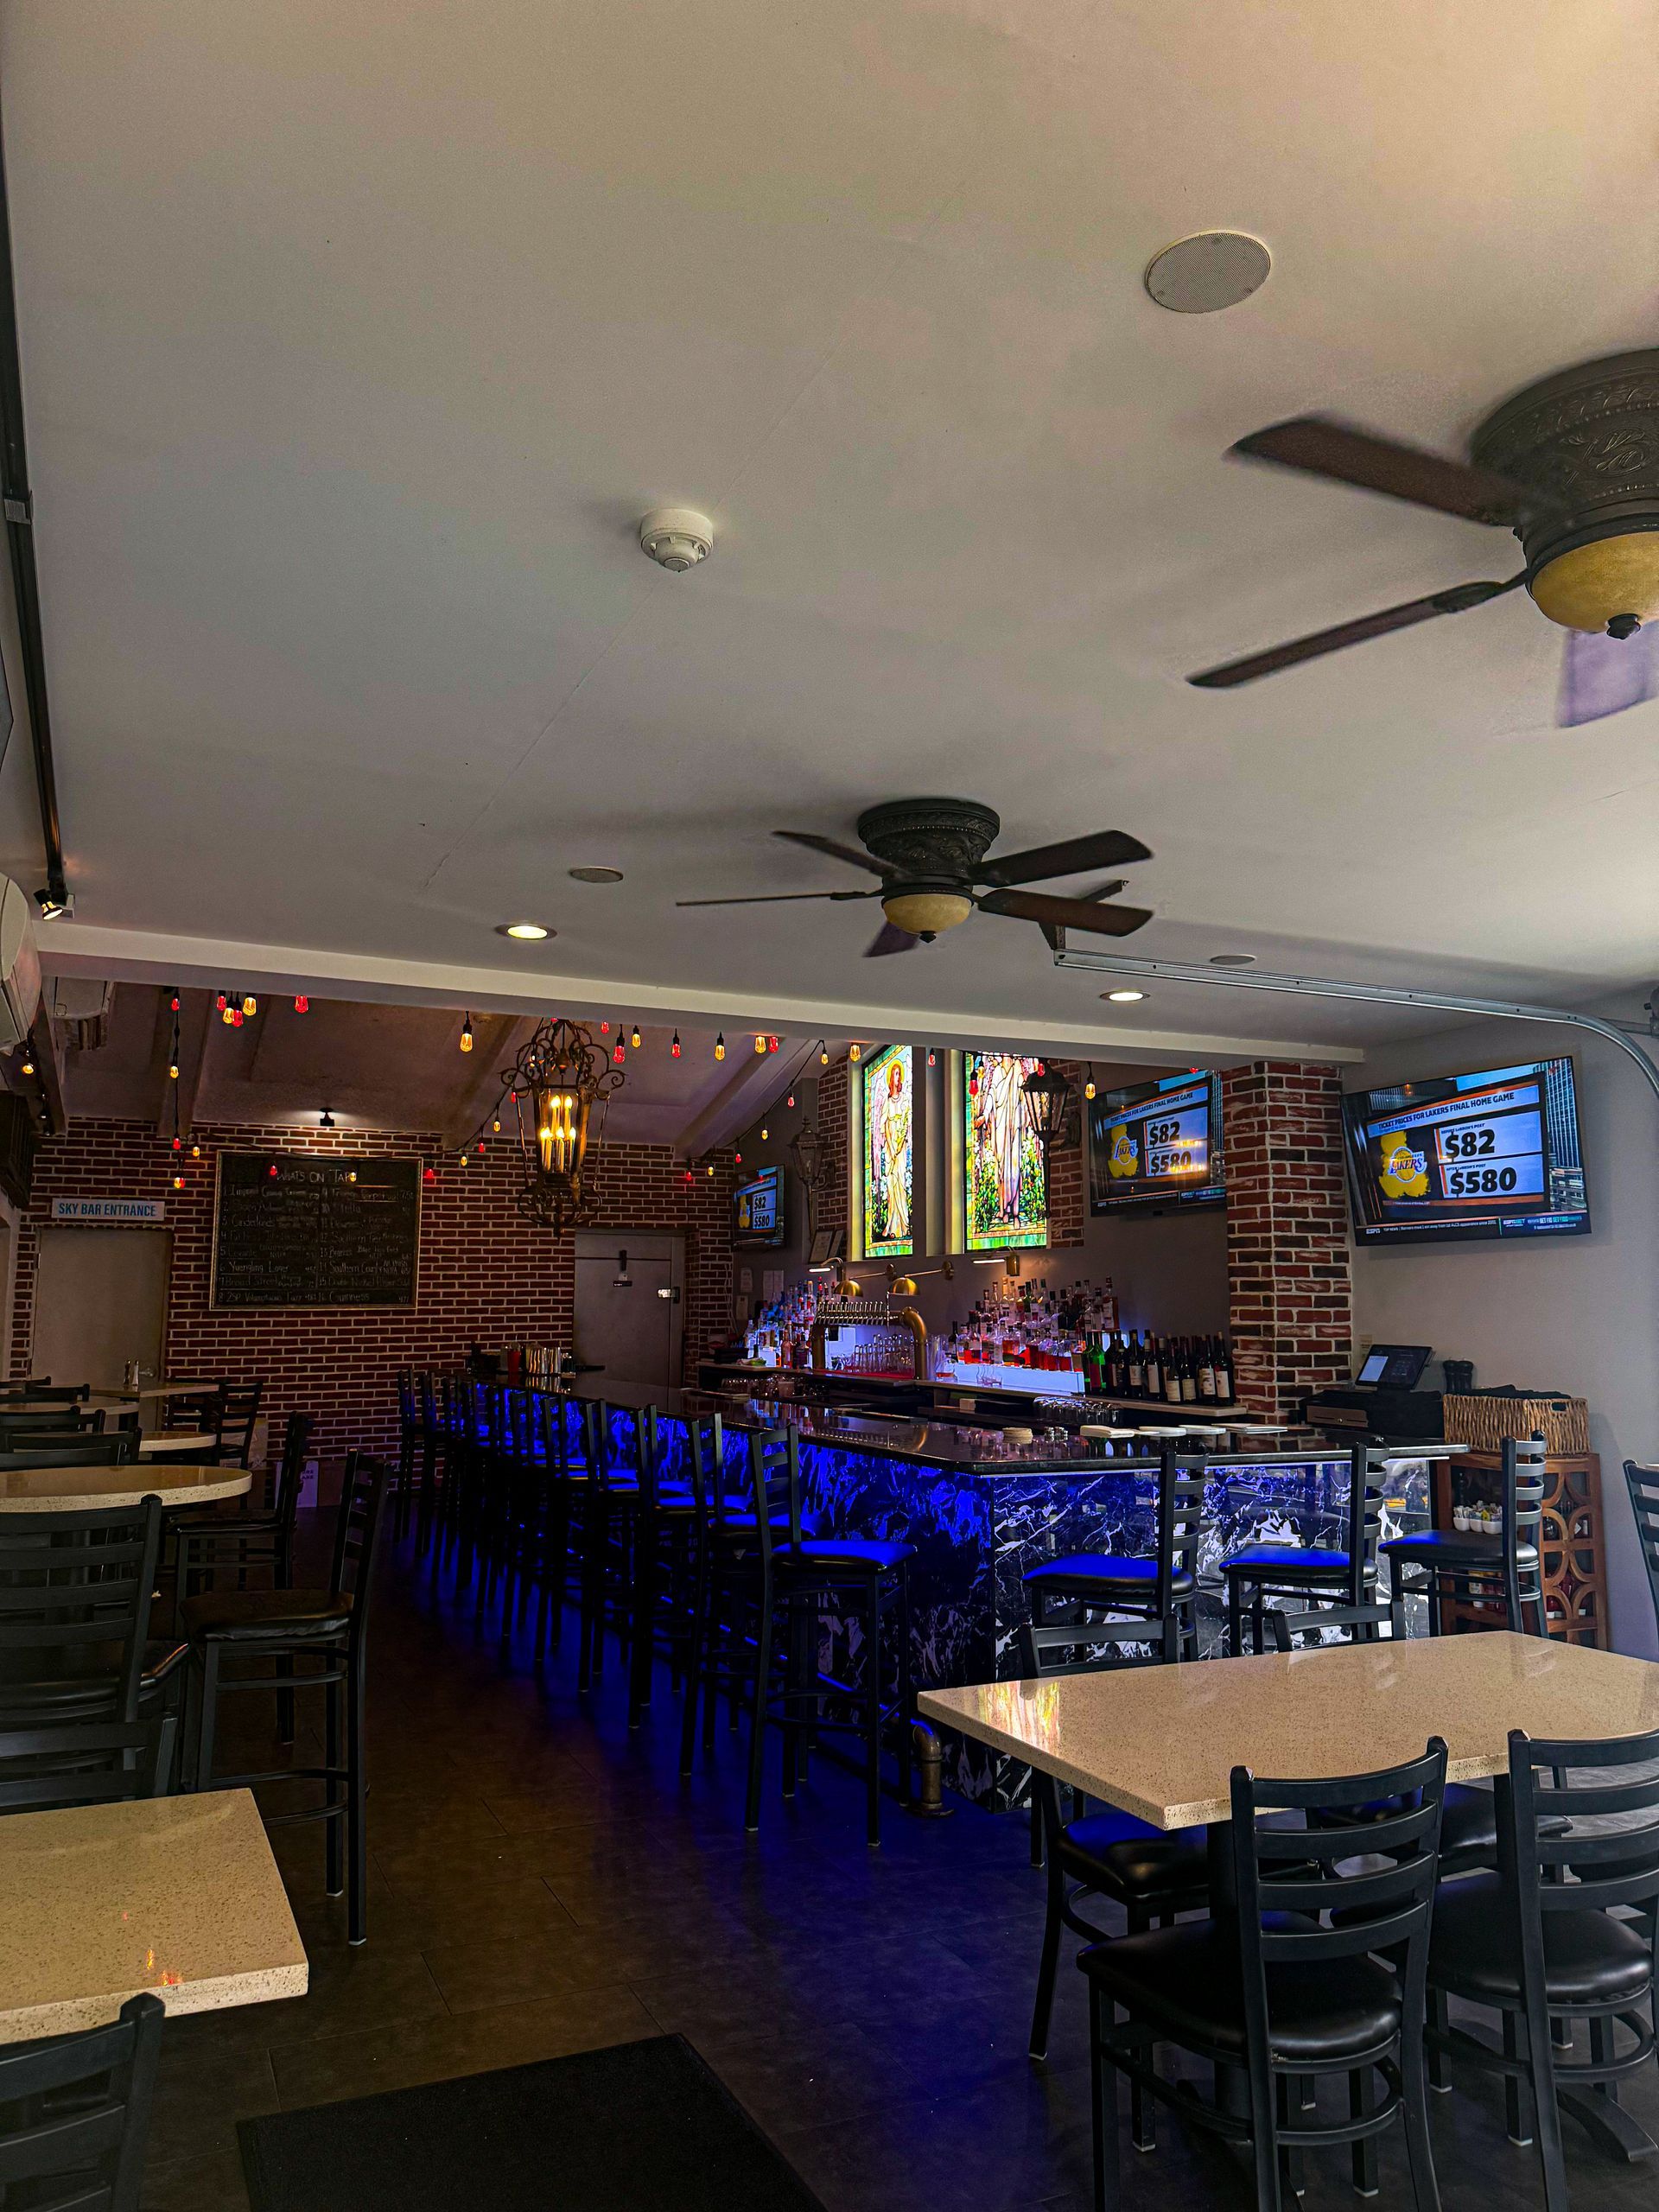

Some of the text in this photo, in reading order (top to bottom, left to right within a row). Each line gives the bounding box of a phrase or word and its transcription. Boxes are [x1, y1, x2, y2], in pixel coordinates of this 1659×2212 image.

[1378, 1120, 1394, 1130] TICKET
[1395, 1116, 1413, 1126] PRICES
[1425, 1106, 1449, 1117] LAKERS
[1449, 1102, 1470, 1112] FINAL
[1471, 1097, 1492, 1108] HOME
[1493, 1092, 1515, 1103] GAME
[1149, 1121, 1180, 1148] $82
[1445, 1128, 1495, 1162] $82
[309, 1171, 325, 1183] ON
[1151, 1151, 1192, 1176] $580
[1450, 1166, 1516, 1198] $580
[58, 1203, 156, 1217] SKY BAR ENTRANCE
